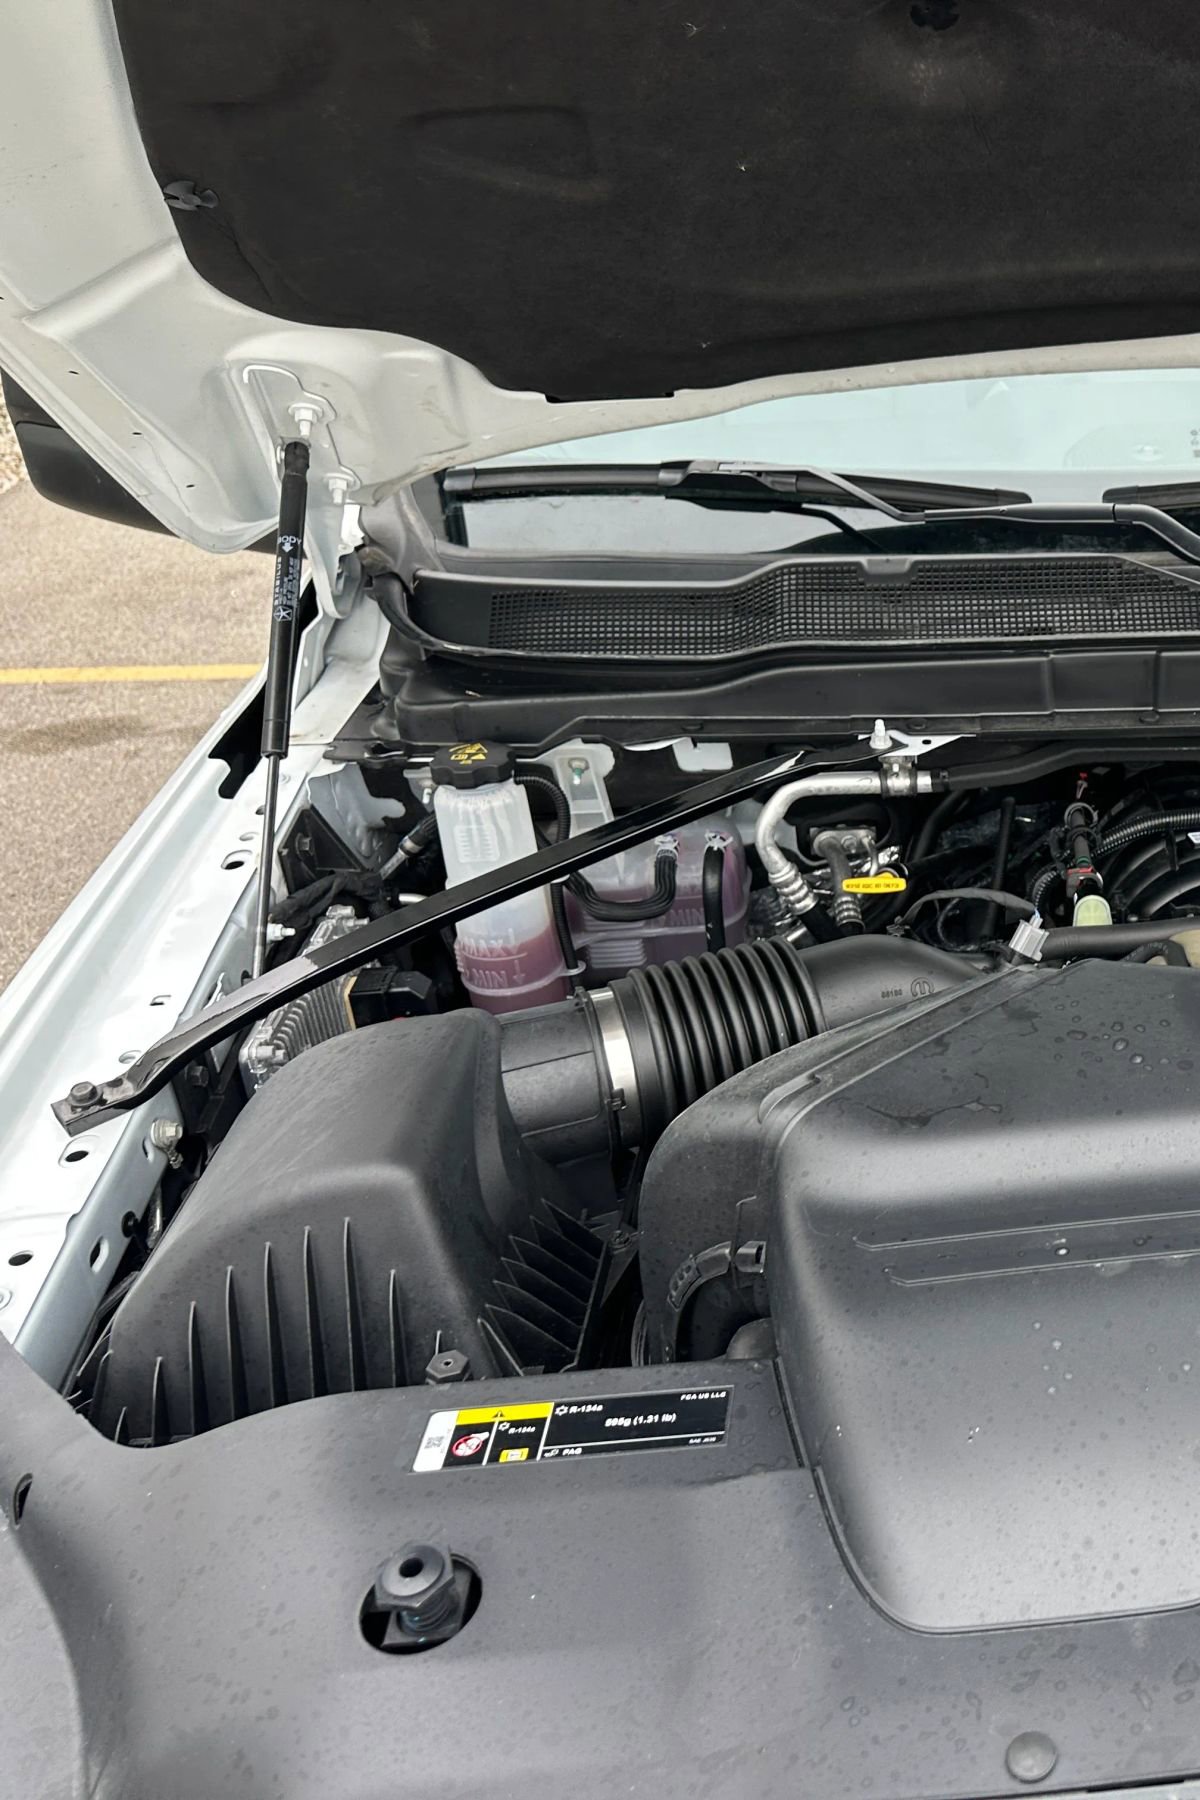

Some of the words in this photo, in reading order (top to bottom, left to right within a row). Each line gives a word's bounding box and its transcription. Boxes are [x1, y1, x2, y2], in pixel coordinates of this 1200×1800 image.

[277, 535, 302, 545] BODY
[274, 556, 282, 606] STABILUS
[463, 936, 508, 958] MAX
[471, 967, 509, 989] MIN
[680, 1393, 698, 1401] FCA
[698, 1392, 710, 1400] US
[710, 1390, 727, 1399] LLC
[568, 1404, 604, 1415] R-134a
[661, 1412, 677, 1423] lb)
[562, 1447, 583, 1456] PAG
